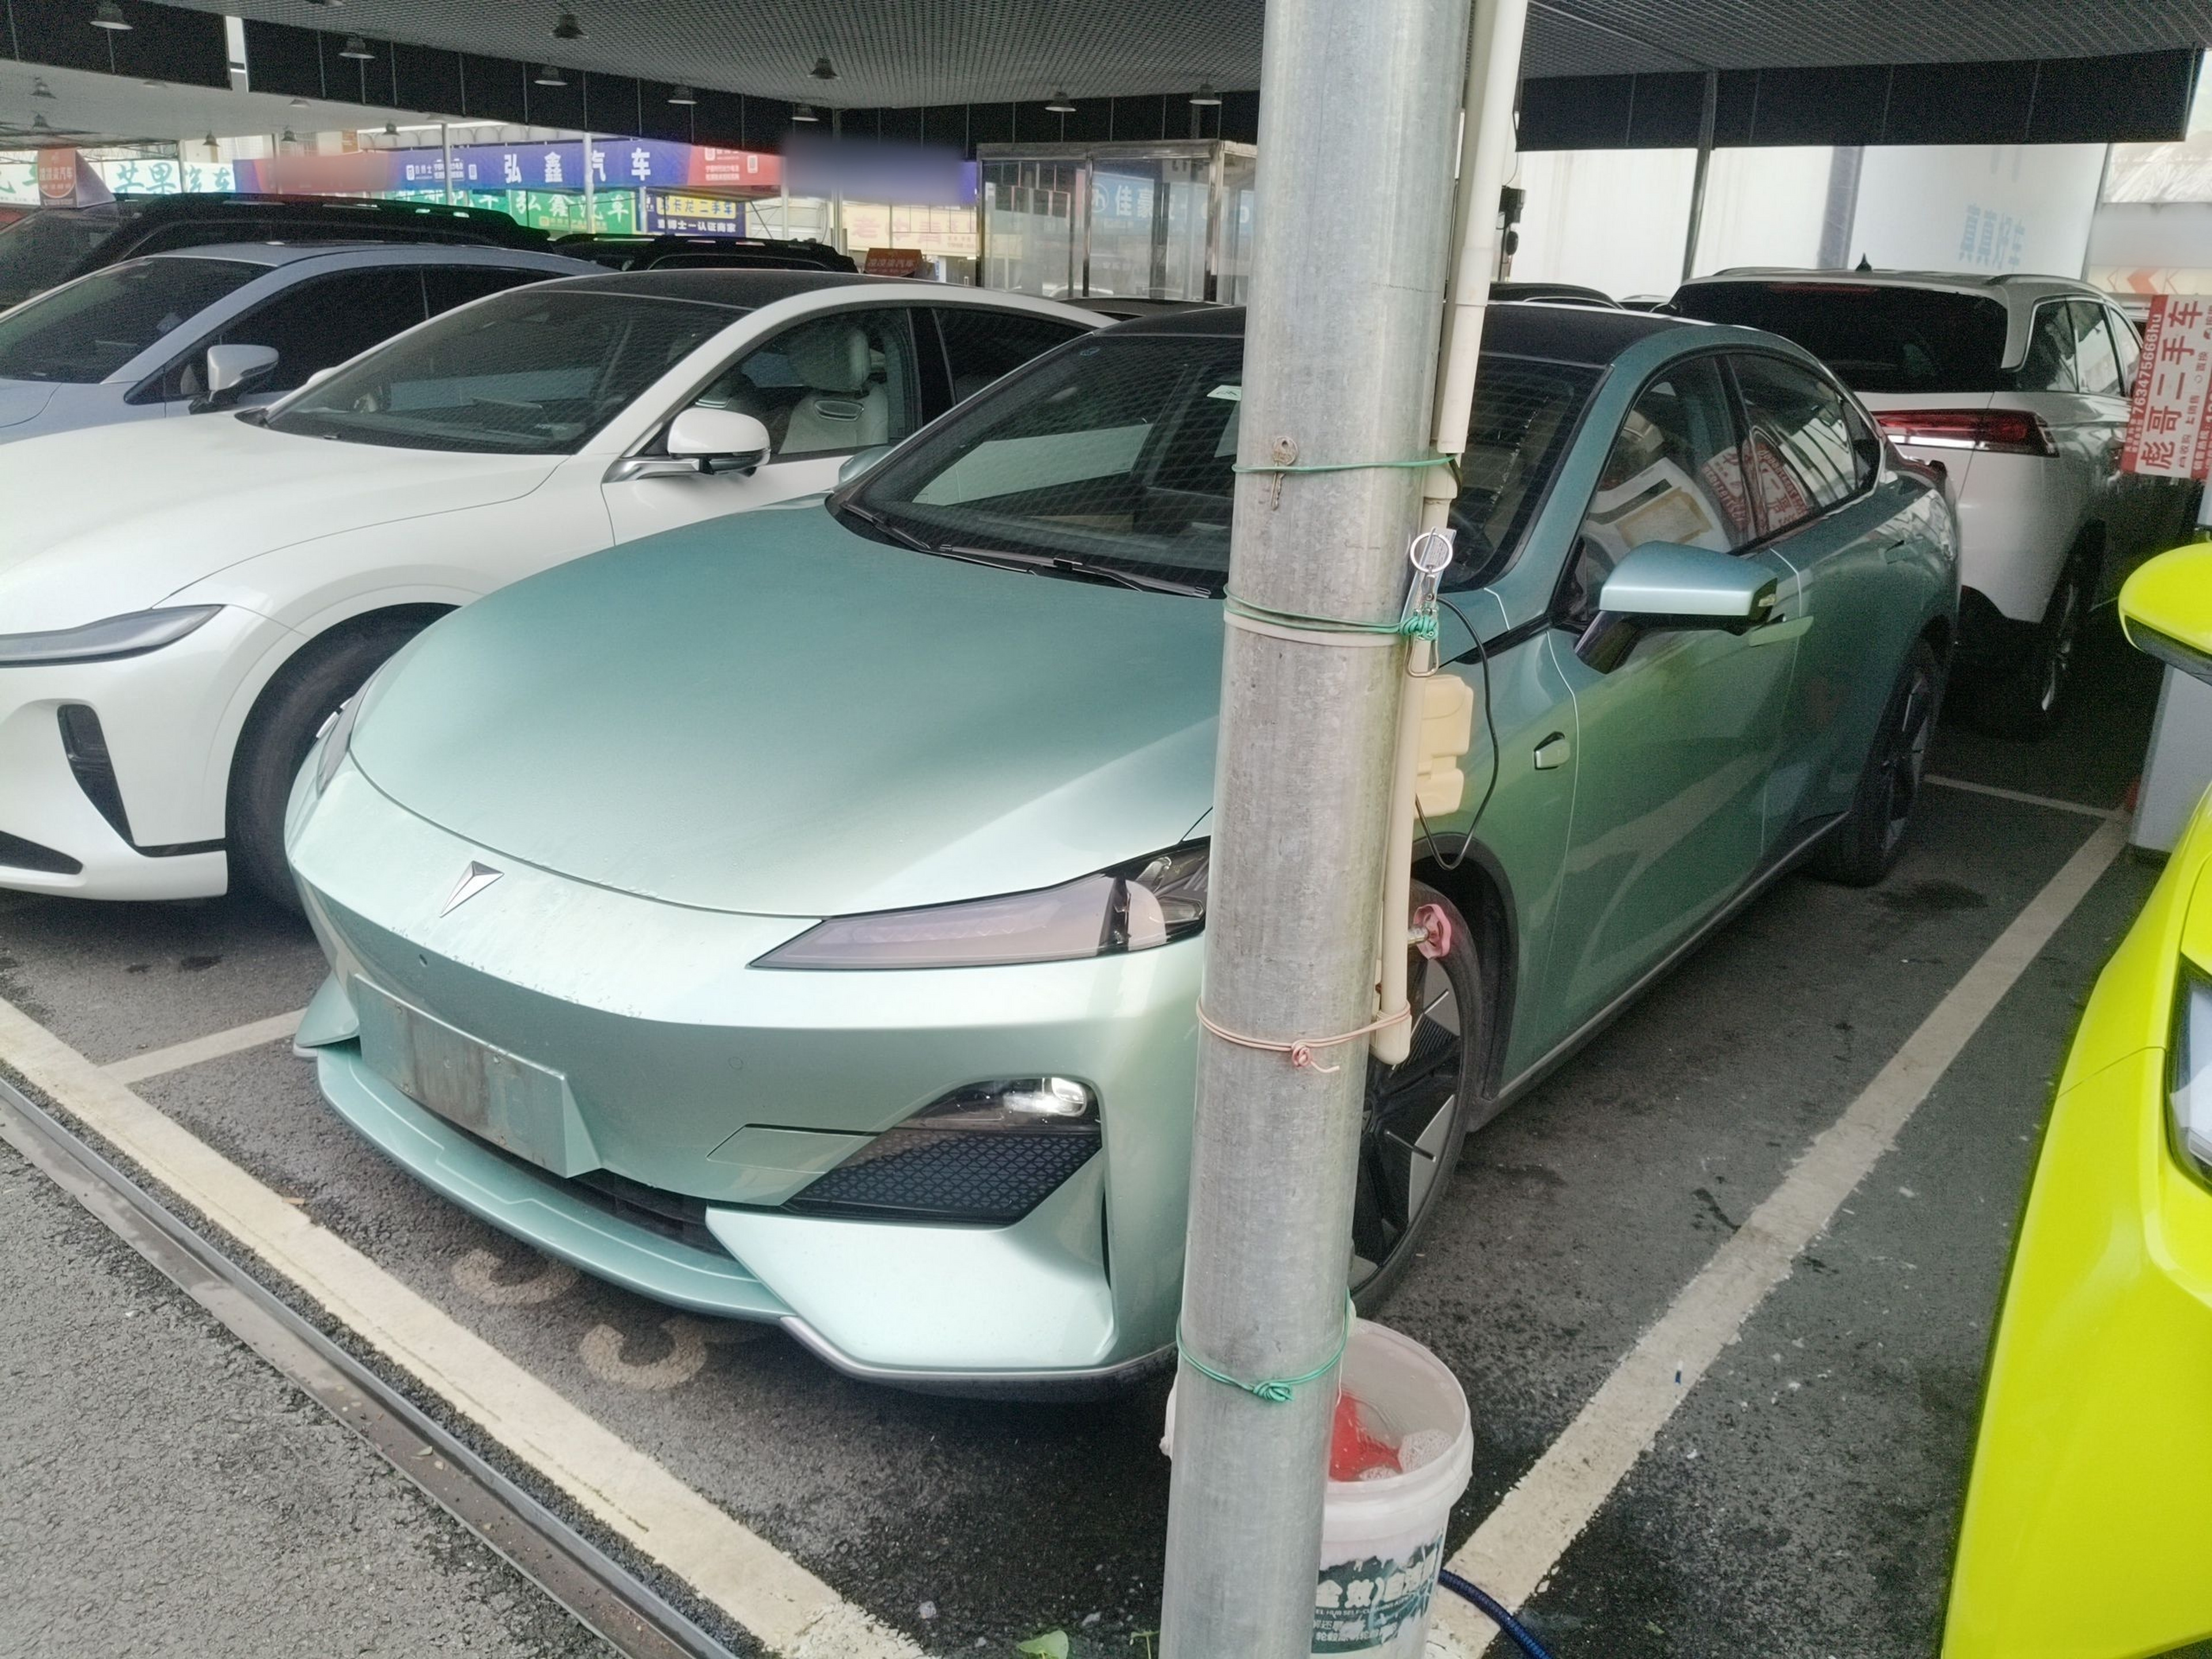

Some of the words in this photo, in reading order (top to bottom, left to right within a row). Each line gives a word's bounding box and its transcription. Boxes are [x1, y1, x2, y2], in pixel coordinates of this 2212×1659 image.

[505, 147, 651, 183] 弘鑫汽车
[2141, 301, 2203, 469] 彪哥二手车
